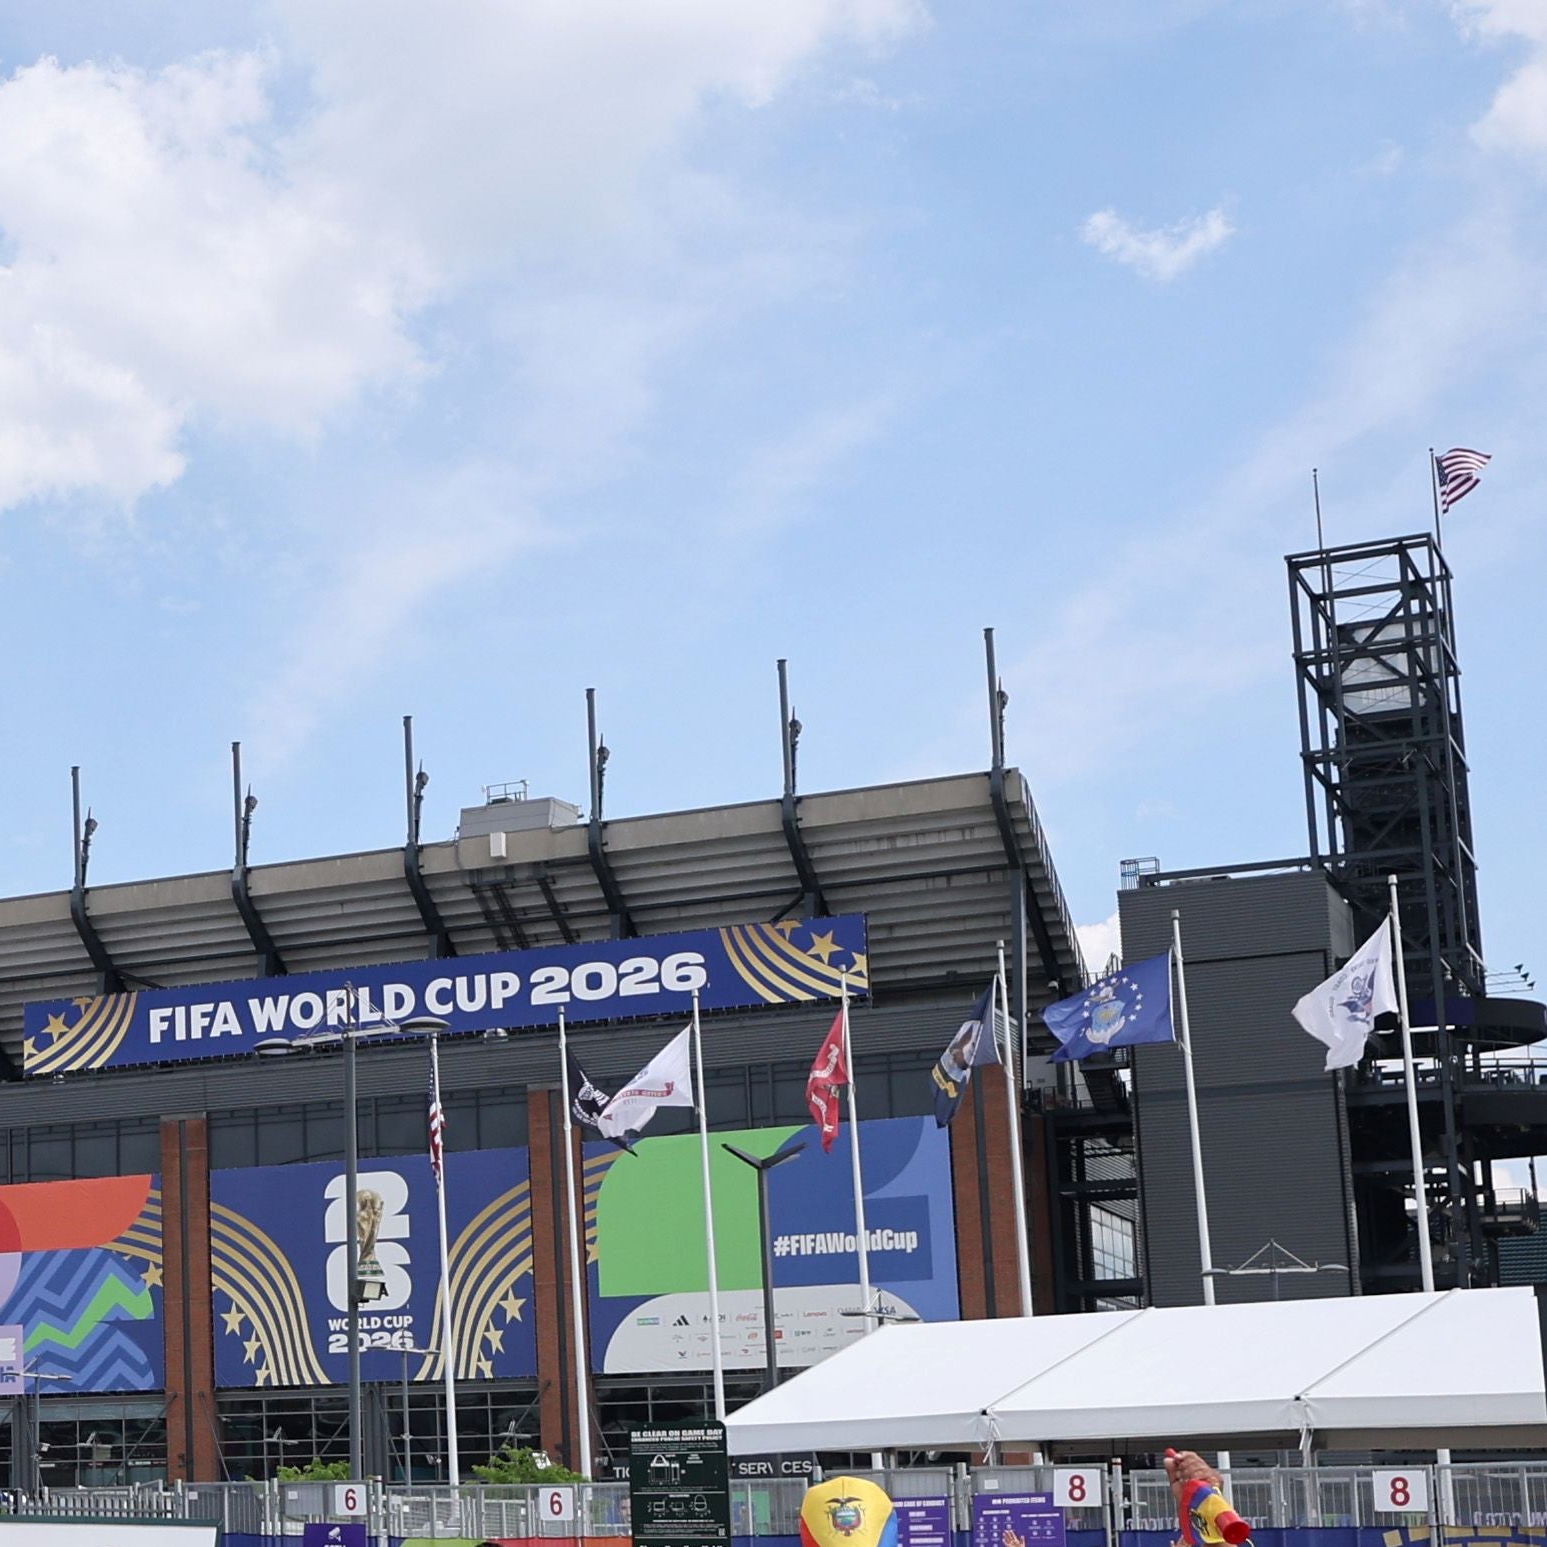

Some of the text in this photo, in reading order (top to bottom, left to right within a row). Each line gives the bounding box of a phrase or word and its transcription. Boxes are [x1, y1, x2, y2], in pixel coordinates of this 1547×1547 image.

[149, 951, 709, 1044] FIFA WORLD CUP 2026
[773, 1229, 918, 1257] #FIFAWoldCup
[383, 1315, 414, 1329] CUP
[345, 1488, 356, 1511] 6
[1068, 1474, 1086, 1502] 8
[1390, 1476, 1410, 1507] 8
[549, 1491, 562, 1515] 6
